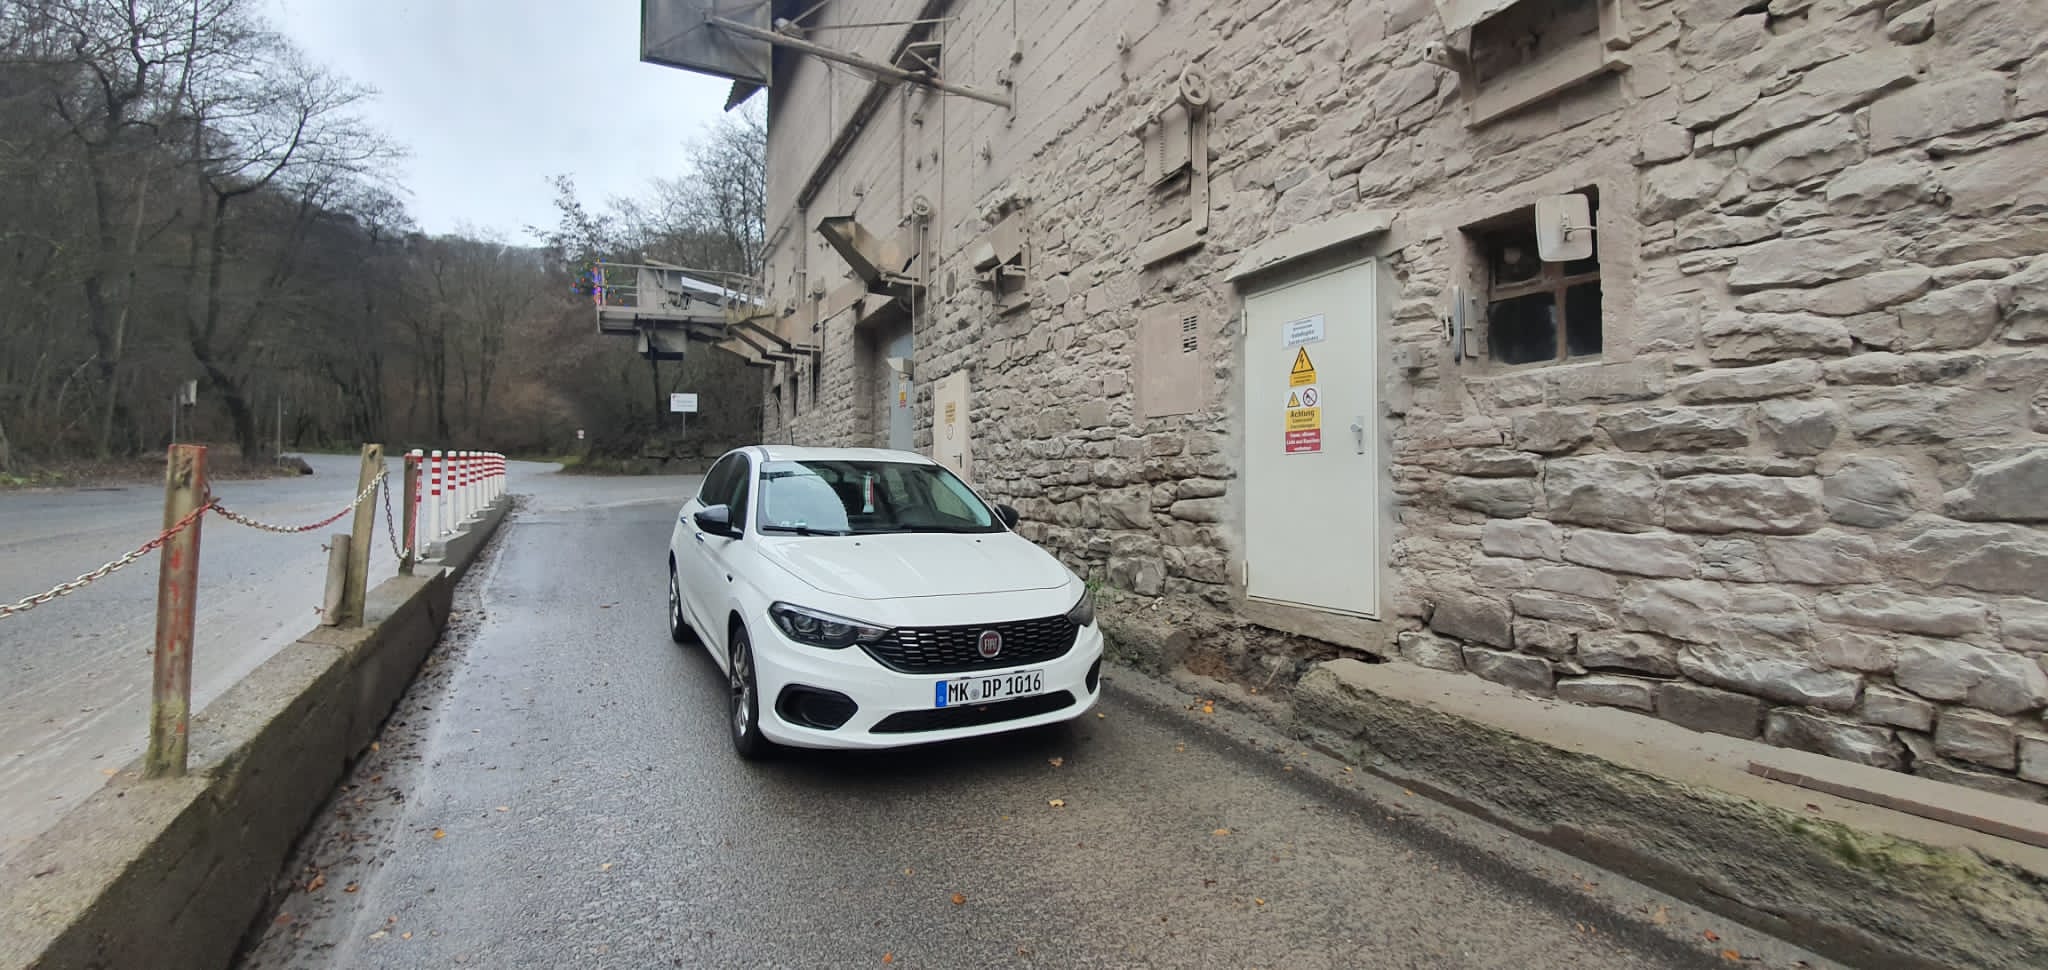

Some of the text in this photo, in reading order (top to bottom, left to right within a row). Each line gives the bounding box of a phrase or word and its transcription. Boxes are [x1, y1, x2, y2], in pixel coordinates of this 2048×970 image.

[1290, 409, 1315, 418] Achtung
[948, 673, 1041, 703] MK DP 1016
